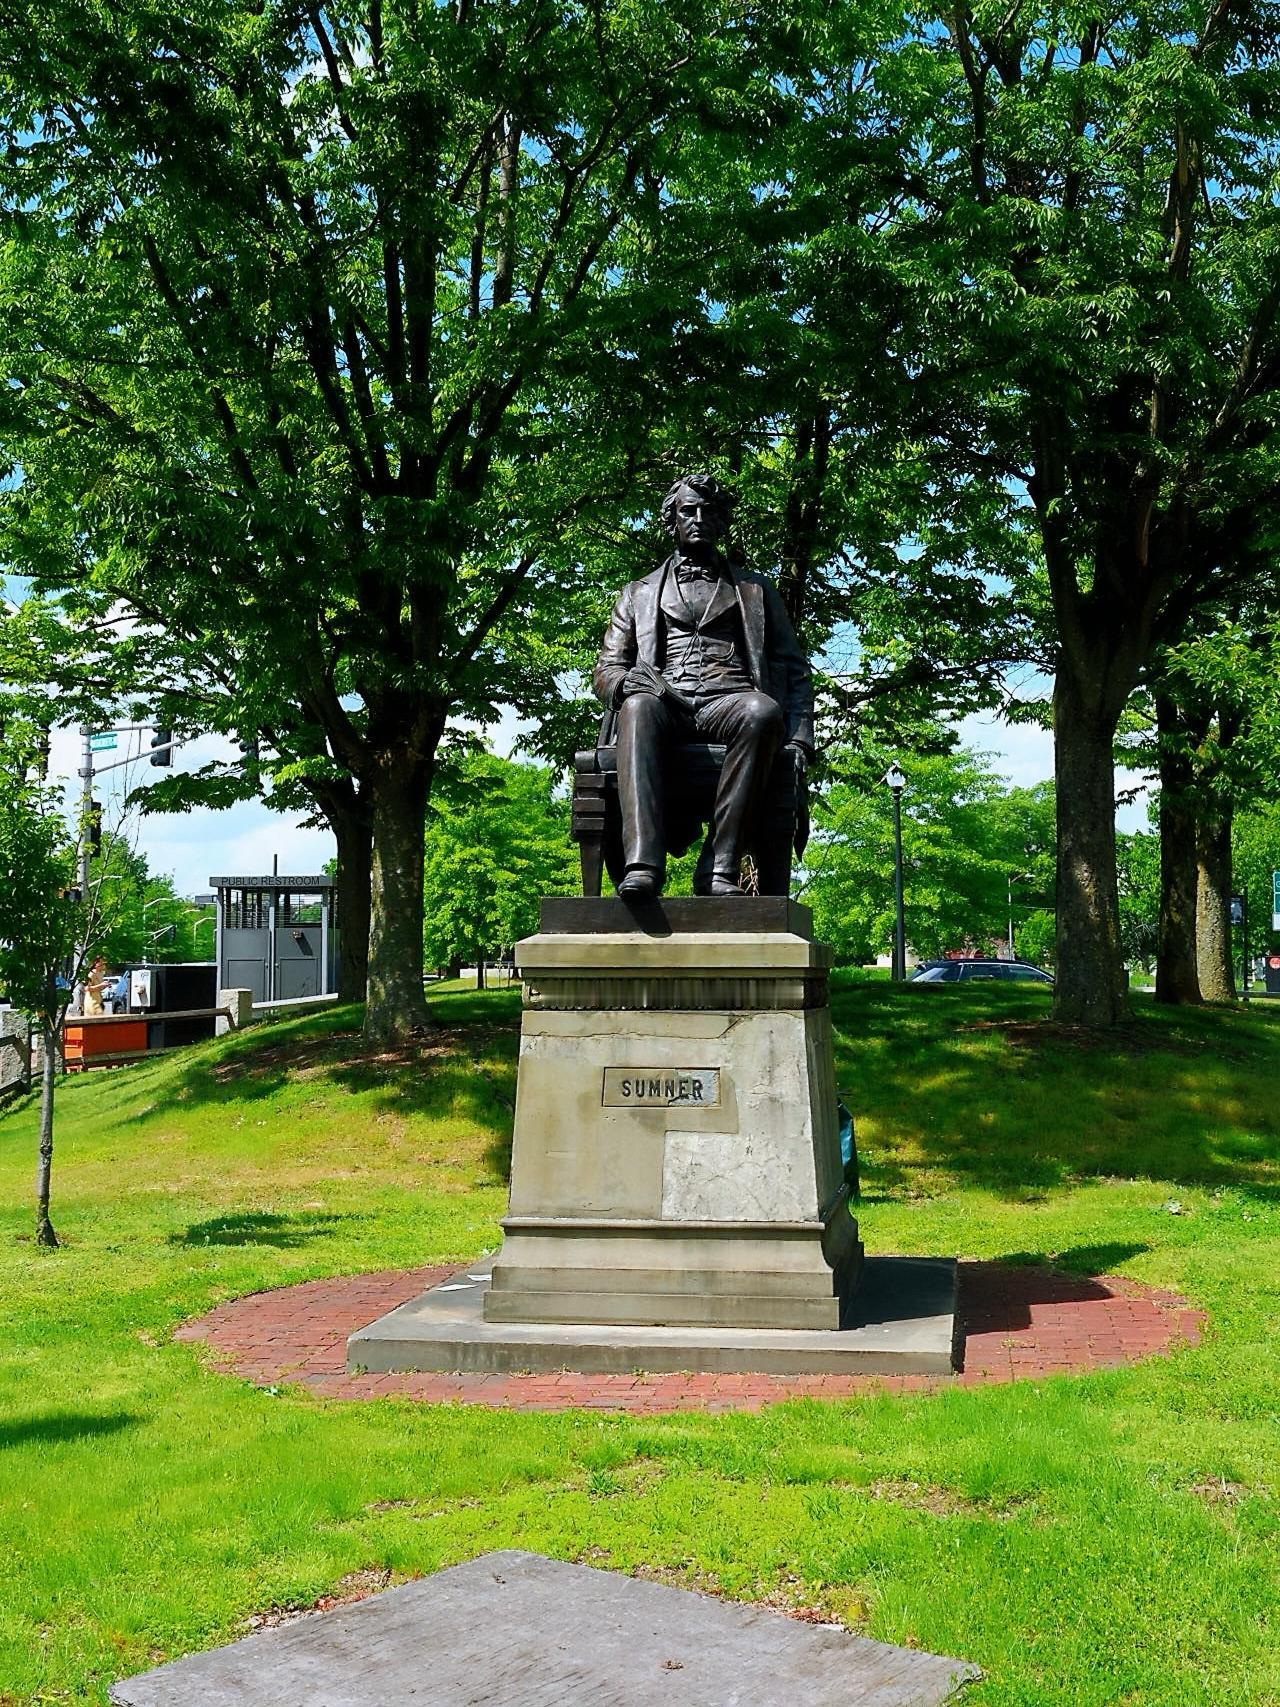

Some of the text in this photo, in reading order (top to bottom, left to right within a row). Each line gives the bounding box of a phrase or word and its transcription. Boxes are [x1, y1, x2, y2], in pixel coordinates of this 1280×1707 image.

[221, 876, 320, 886] PUBLIC RESTROOM
[622, 1079, 704, 1100] SUMNER
